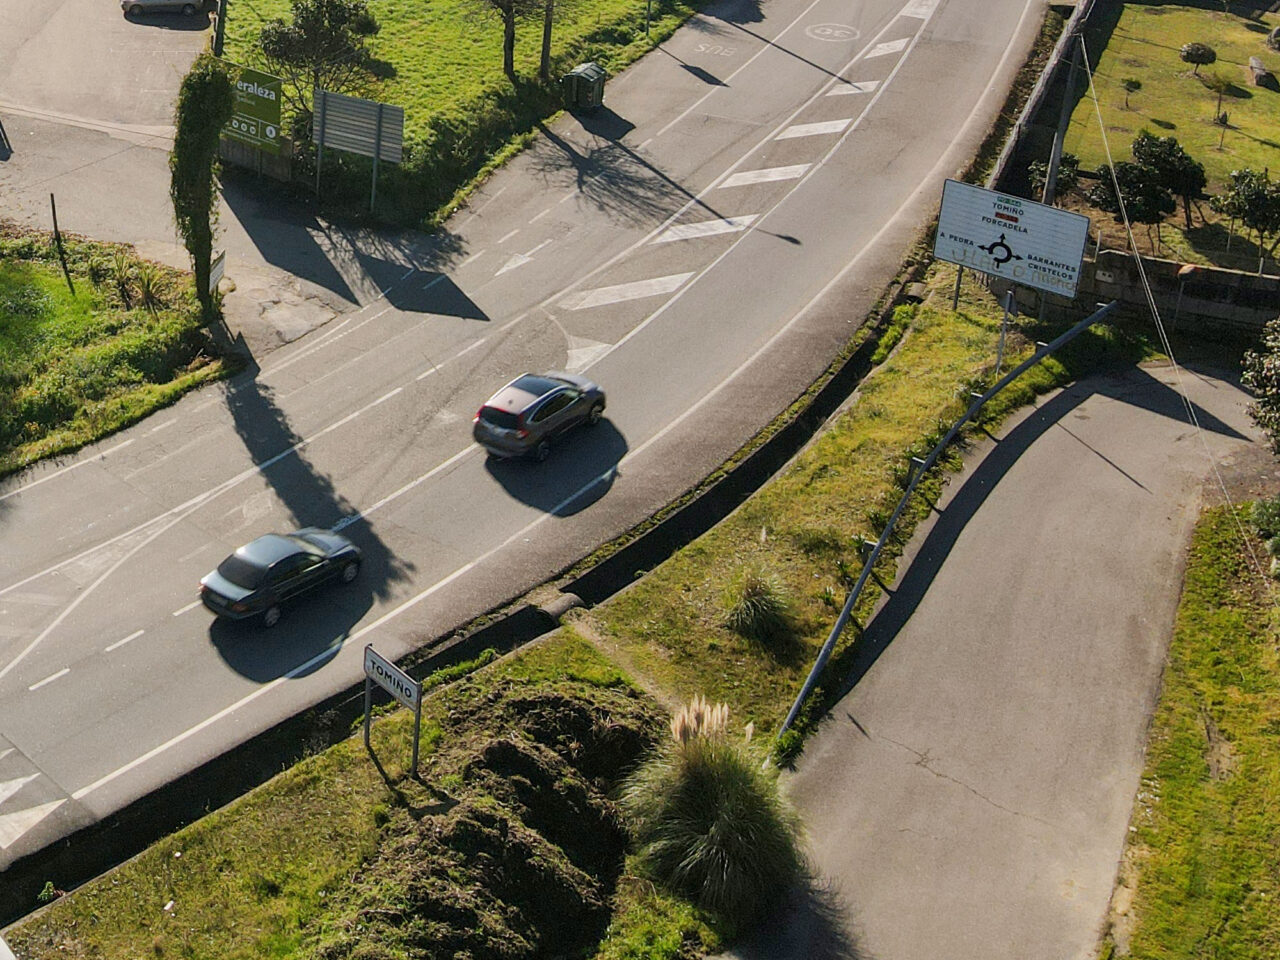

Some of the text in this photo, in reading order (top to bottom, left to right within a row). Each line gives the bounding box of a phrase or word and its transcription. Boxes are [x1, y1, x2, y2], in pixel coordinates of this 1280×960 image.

[236, 80, 276, 101] eraleza
[981, 216, 1028, 234] FORCADELA
[949, 233, 974, 246] PEDRA
[1027, 254, 1077, 273] BARRANTES
[1028, 263, 1073, 280] CRISTELOS
